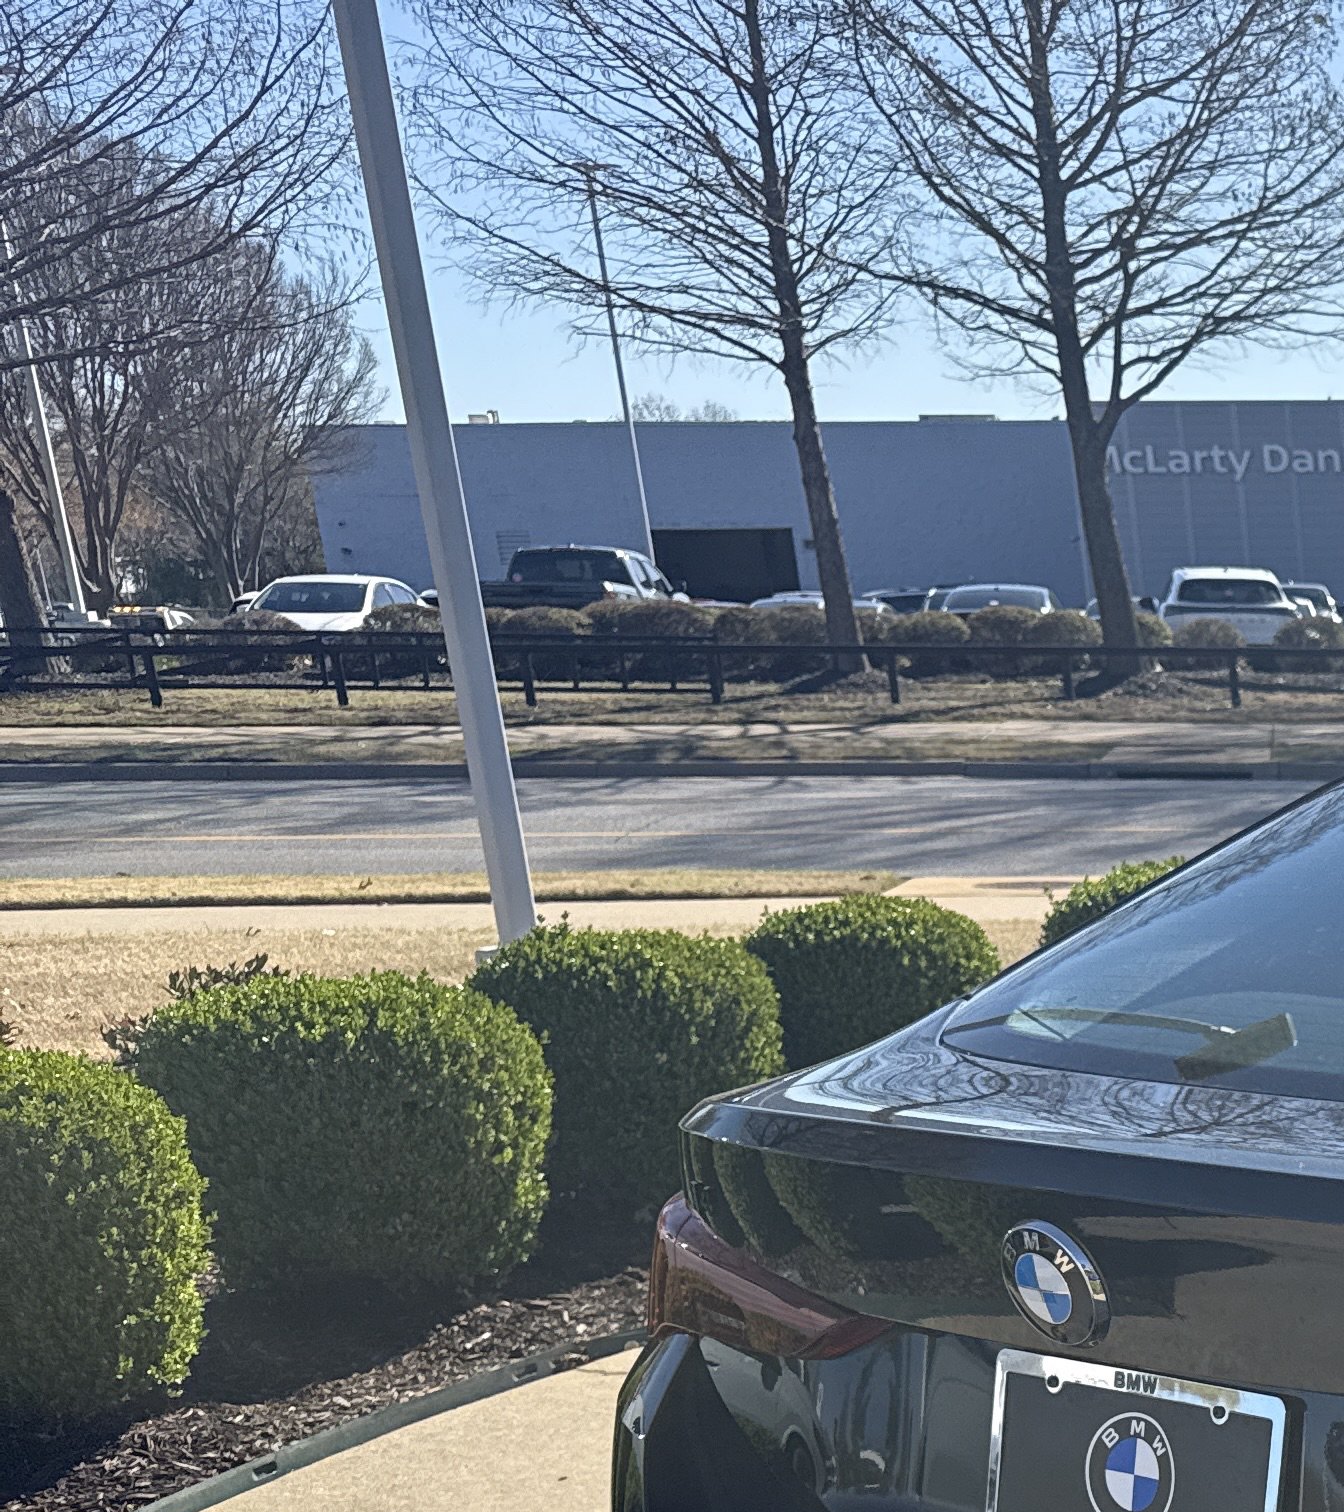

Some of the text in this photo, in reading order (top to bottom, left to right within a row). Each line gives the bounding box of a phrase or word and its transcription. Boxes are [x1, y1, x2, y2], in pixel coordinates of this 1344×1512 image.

[1003, 1231, 1075, 1273] BMW
[1113, 1370, 1159, 1394] BMW
[1101, 1419, 1166, 1457] BMW
